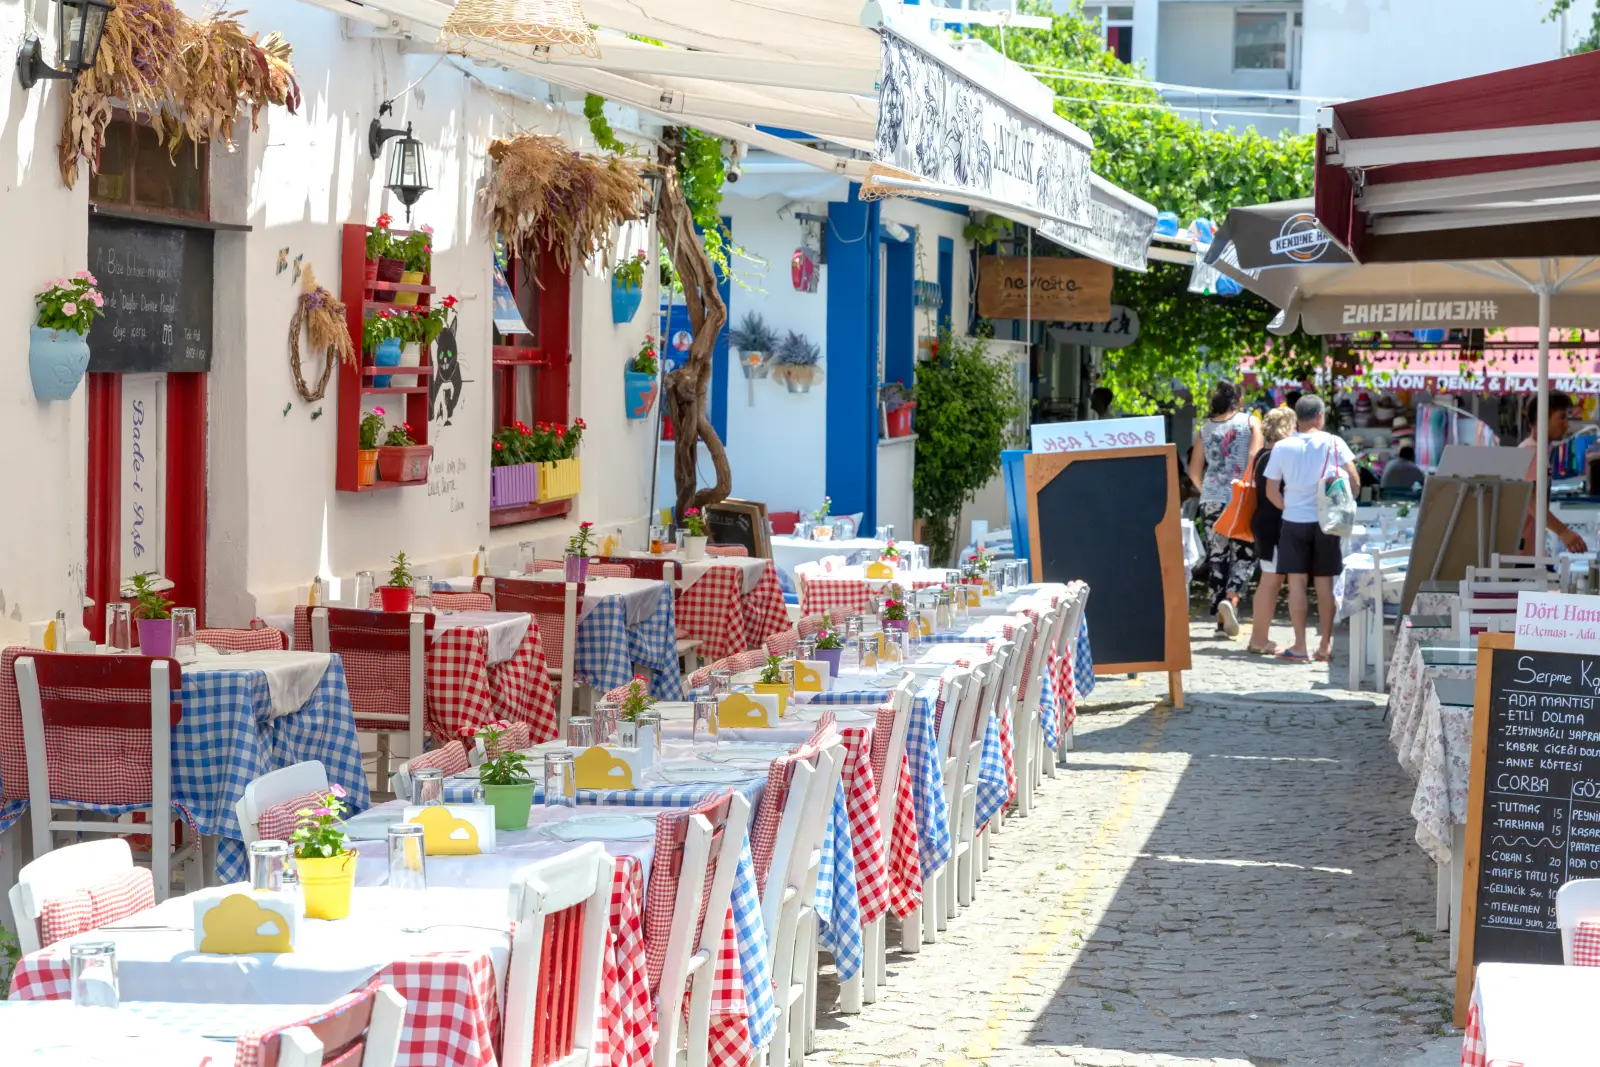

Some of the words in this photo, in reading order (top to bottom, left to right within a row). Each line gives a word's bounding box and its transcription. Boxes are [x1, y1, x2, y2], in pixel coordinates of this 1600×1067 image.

[1504, 377, 1540, 392] PLA
[1524, 602, 1559, 620] Dört
[1518, 624, 1531, 636] El
[1531, 625, 1567, 639] Açması
[1576, 628, 1596, 640] Ada
[1513, 655, 1572, 688] Serpme
[1508, 693, 1537, 707] ADA
[1540, 696, 1594, 710] MANTISI
[1542, 711, 1585, 725] DOLMA
[1568, 729, 1600, 742] YAPRA
[1506, 741, 1540, 753] KABAK
[1506, 758, 1534, 769] ANNE
[1497, 773, 1549, 793] ÇORBA
[1498, 801, 1541, 815] TUTMAÇ
[1553, 807, 1562, 820] 15
[1498, 818, 1545, 832] TARHANA
[1551, 824, 1562, 836] 15
[1491, 850, 1522, 863] ÇOBAN
[1549, 857, 1561, 868] 20
[1569, 858, 1587, 869] ADA
[1549, 872, 1560, 884] 15
[1490, 902, 1541, 914] MENEMEN
